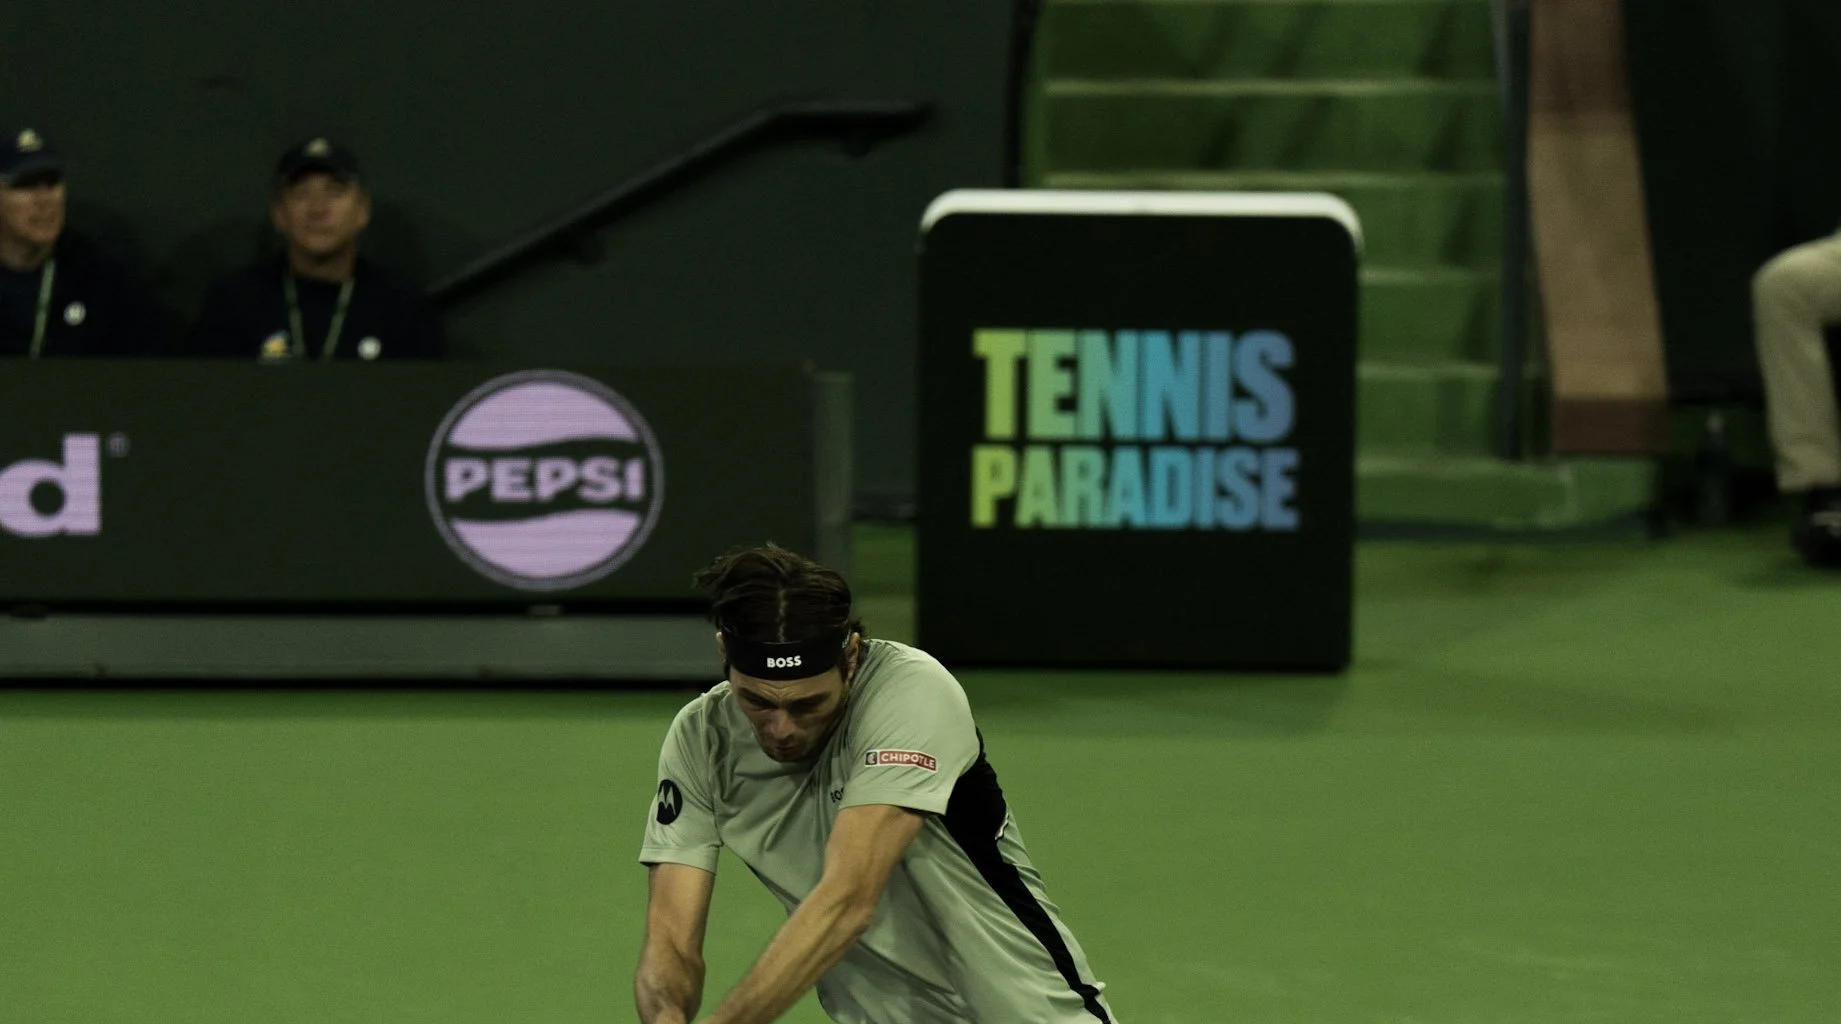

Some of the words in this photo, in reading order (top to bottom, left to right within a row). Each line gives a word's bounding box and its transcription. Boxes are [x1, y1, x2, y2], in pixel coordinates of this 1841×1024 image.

[971, 327, 1297, 443] TENNIS
[444, 455, 646, 504] PEPSI
[970, 443, 1302, 532] PARADISE
[766, 655, 802, 668] BOSS
[881, 752, 935, 769] CHIPOTLE
